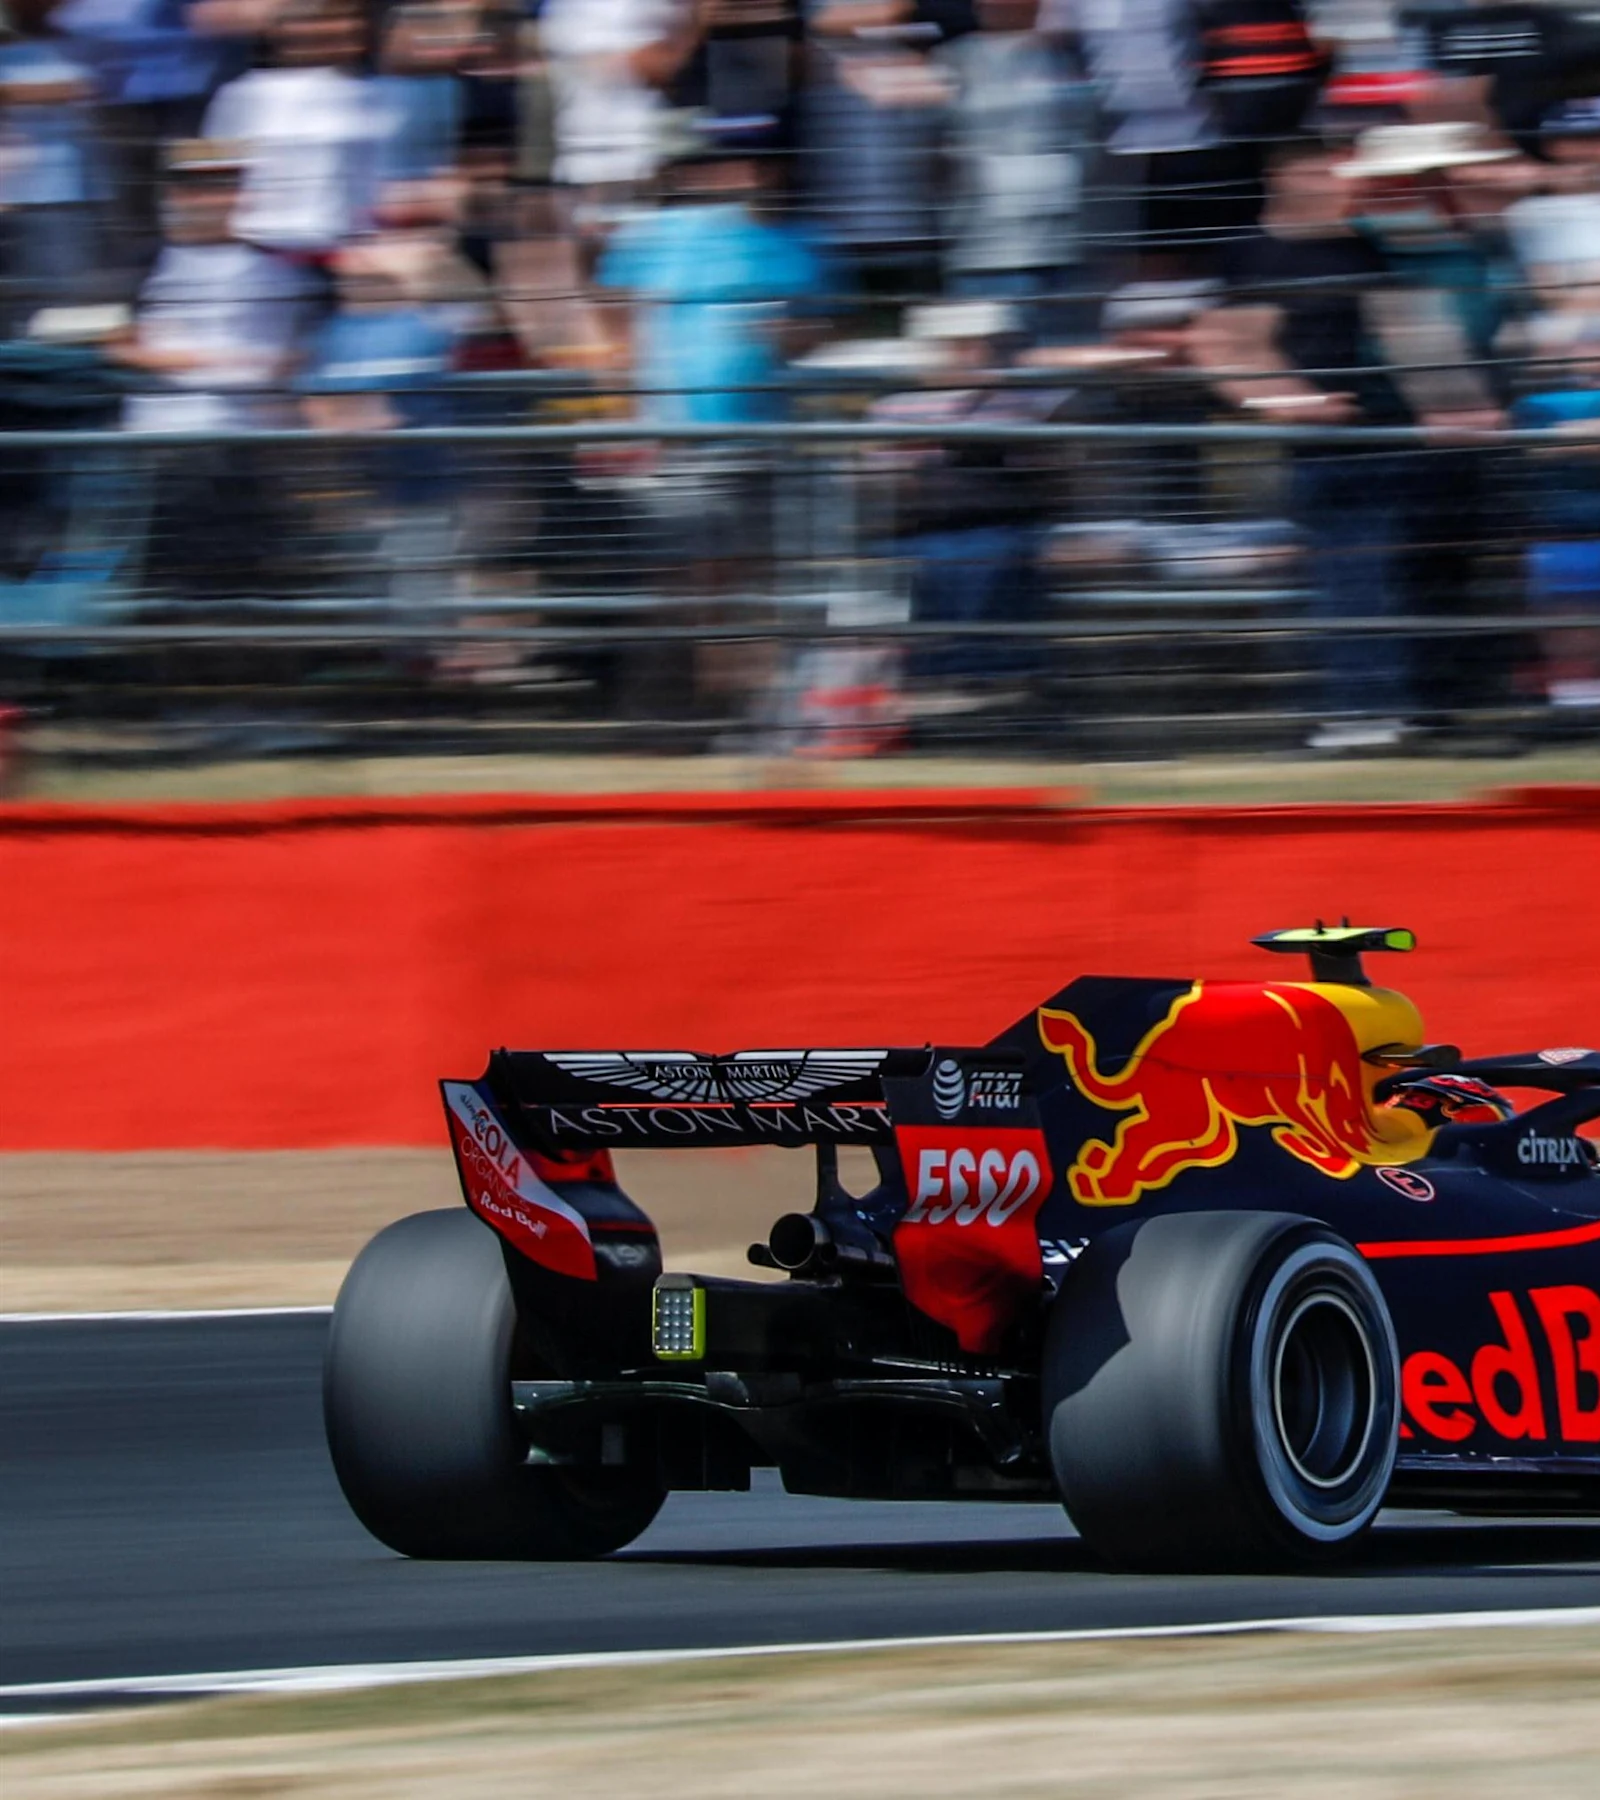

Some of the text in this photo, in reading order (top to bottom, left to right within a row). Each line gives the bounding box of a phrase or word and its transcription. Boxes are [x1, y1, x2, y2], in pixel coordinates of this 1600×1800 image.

[654, 1064, 791, 1079] ASTON MARTIN
[968, 1072, 1024, 1108] AT&T
[474, 1108, 522, 1190] COLA
[550, 1105, 892, 1136] ASTON MART
[460, 1135, 531, 1213] ORGANICS
[901, 1147, 1041, 1227] ESSO
[479, 1190, 513, 1218] Red
[515, 1211, 548, 1240] Bull
[1398, 1290, 1547, 1442] ed
